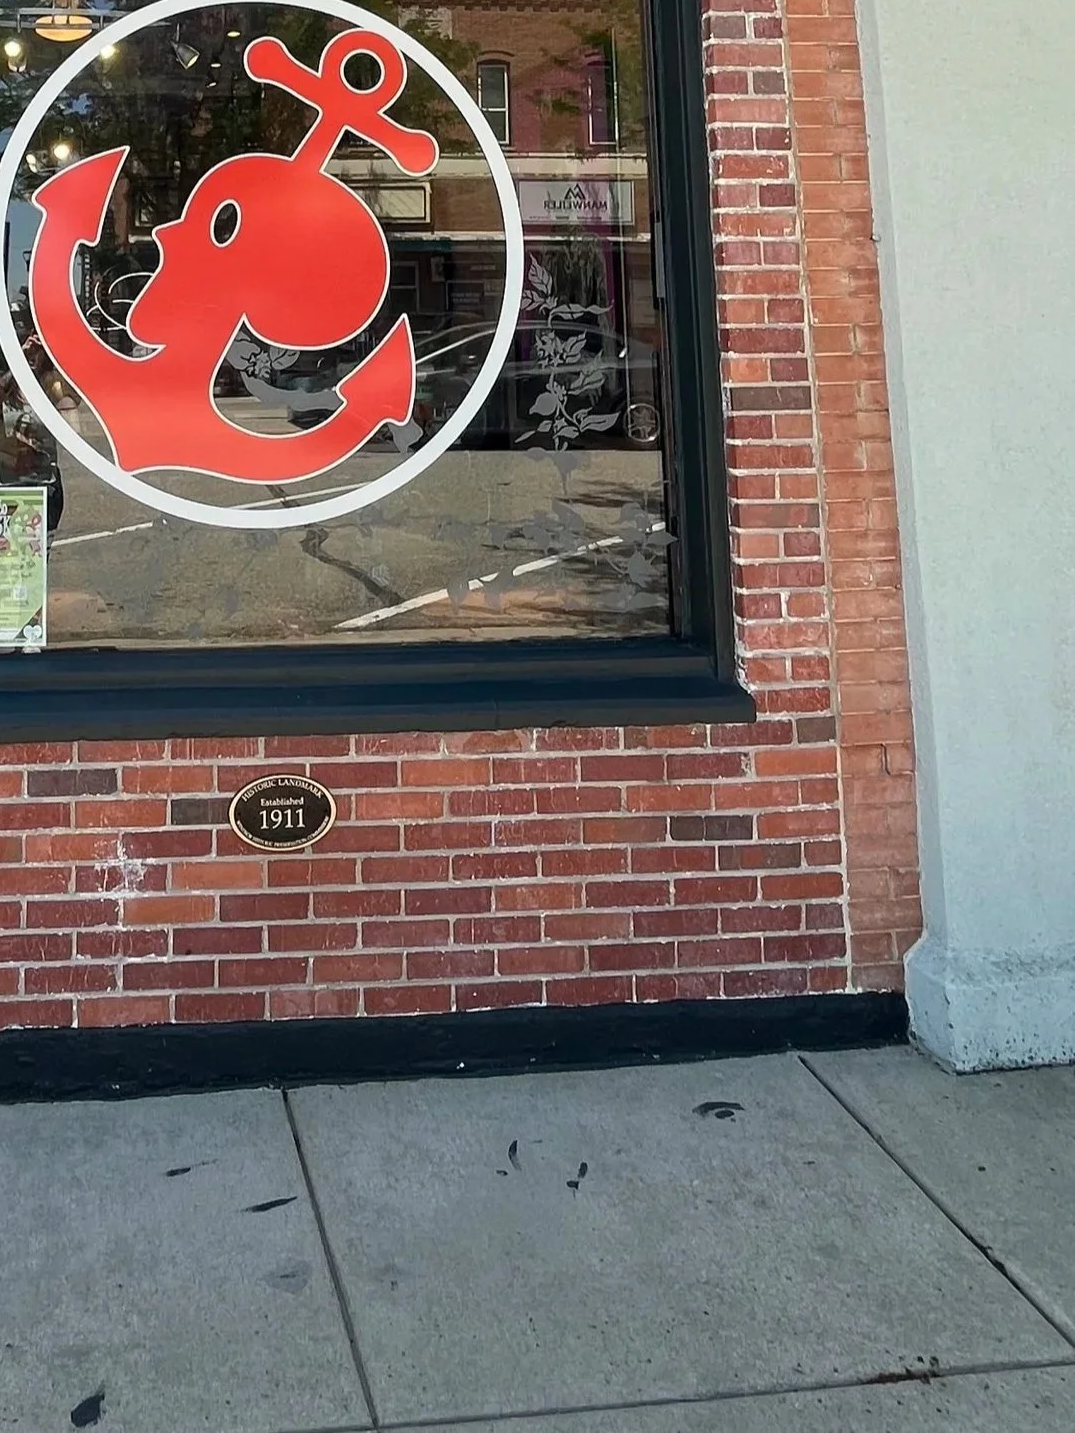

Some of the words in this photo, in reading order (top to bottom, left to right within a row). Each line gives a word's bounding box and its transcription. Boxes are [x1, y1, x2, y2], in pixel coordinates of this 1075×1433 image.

[241, 779, 277, 802] HISTORIC
[278, 778, 324, 799] LANDMARK
[260, 796, 304, 807] Established
[259, 808, 306, 830] 1911
